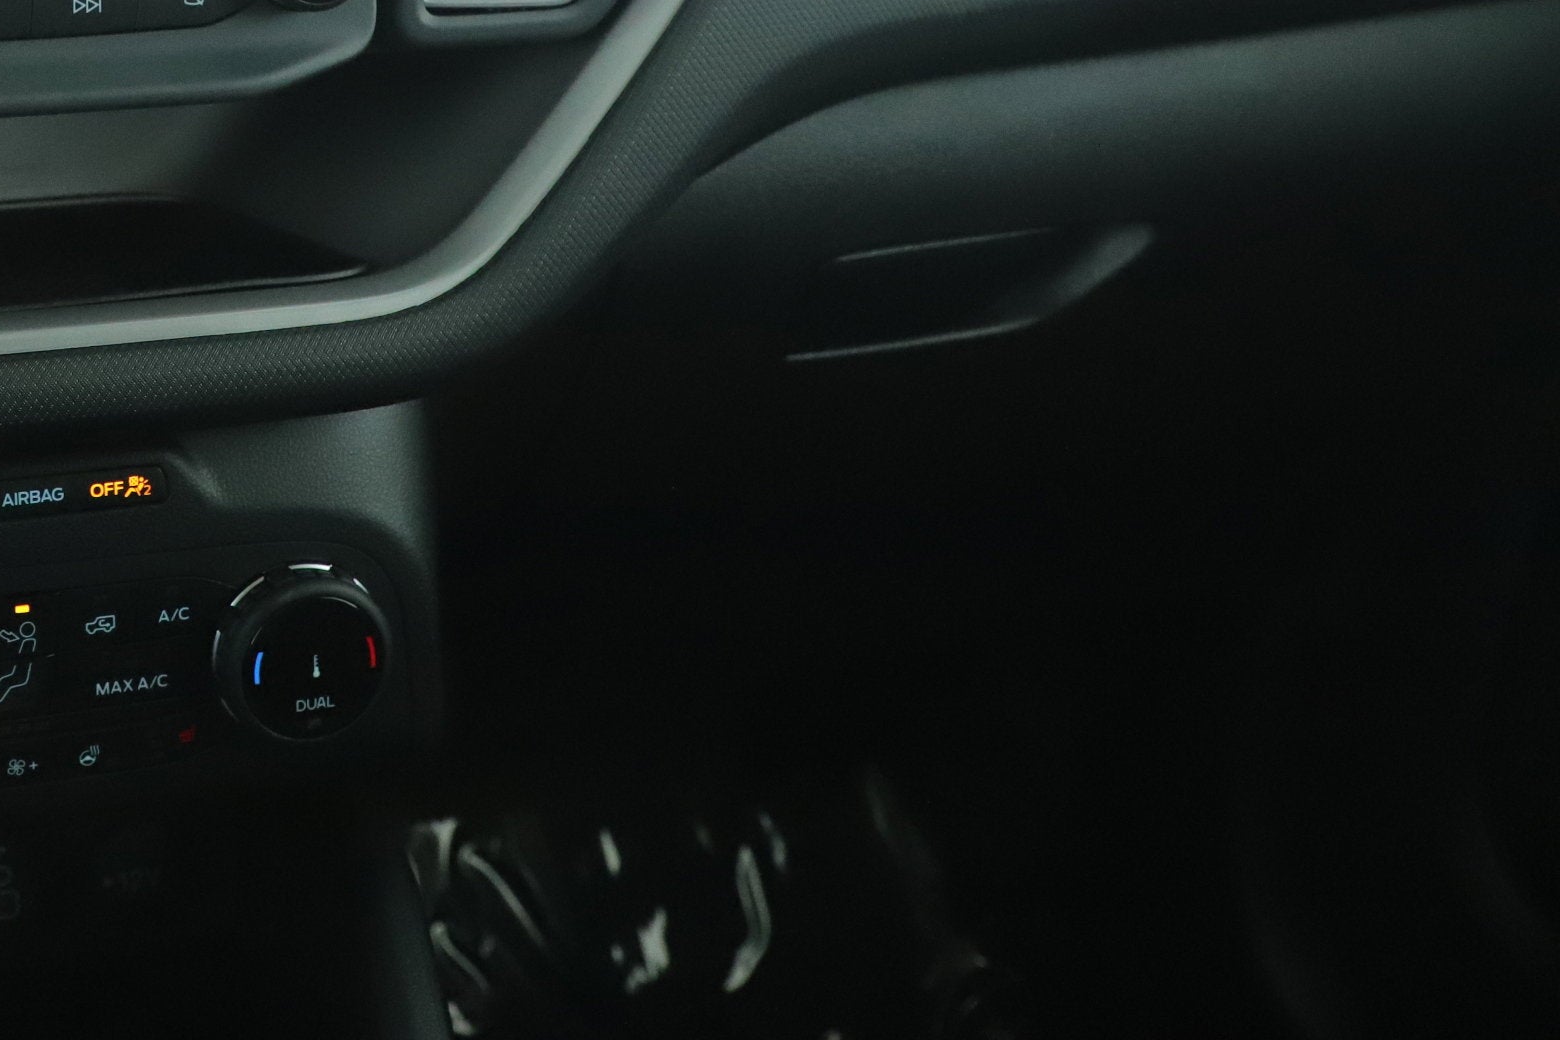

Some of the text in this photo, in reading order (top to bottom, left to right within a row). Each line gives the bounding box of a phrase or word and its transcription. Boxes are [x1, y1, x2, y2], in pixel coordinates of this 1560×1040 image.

[1, 487, 65, 508] AIRBAG
[89, 480, 125, 498] OFF
[158, 606, 190, 623] A/C
[95, 673, 168, 696] MAX A/C
[295, 695, 336, 713] DUAL
